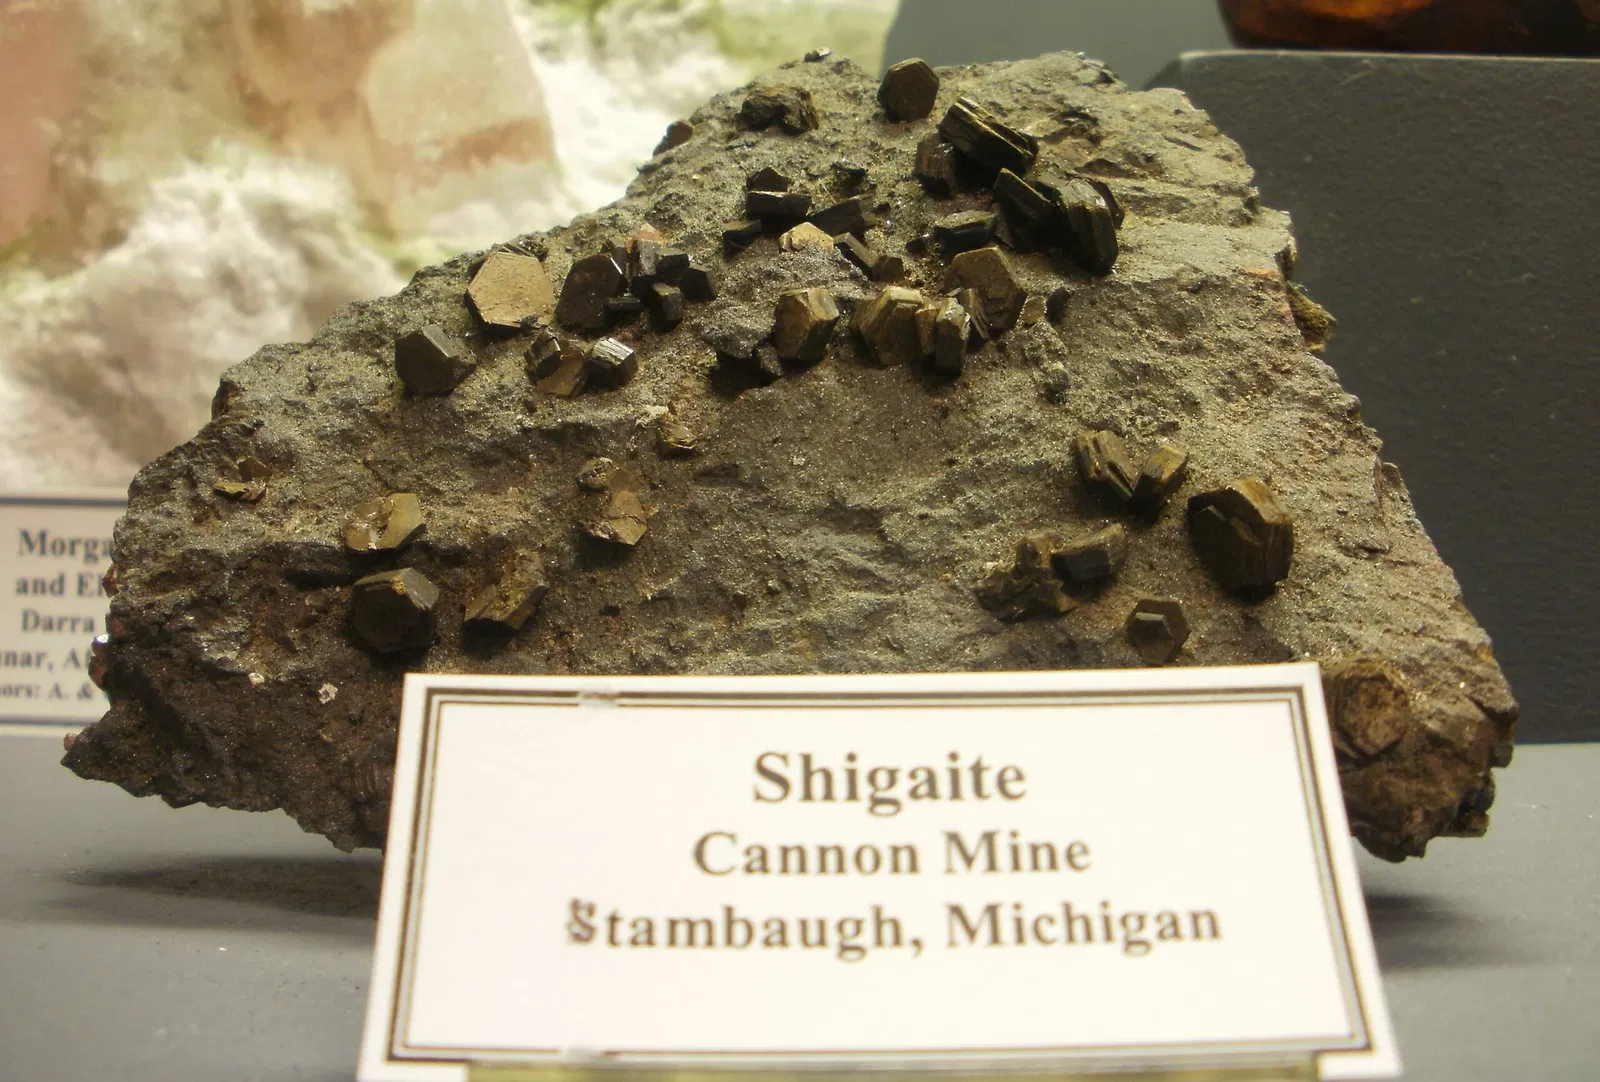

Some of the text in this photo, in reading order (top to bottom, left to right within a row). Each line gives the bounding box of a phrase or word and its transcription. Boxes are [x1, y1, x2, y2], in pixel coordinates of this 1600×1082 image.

[15, 571, 65, 597] and
[21, 608, 95, 634] Darra
[0, 650, 54, 673] nar,
[753, 751, 1027, 817] Shigaite
[693, 829, 1093, 876] Cannon Mine
[566, 897, 1222, 962] Stambaugh, Michigan
